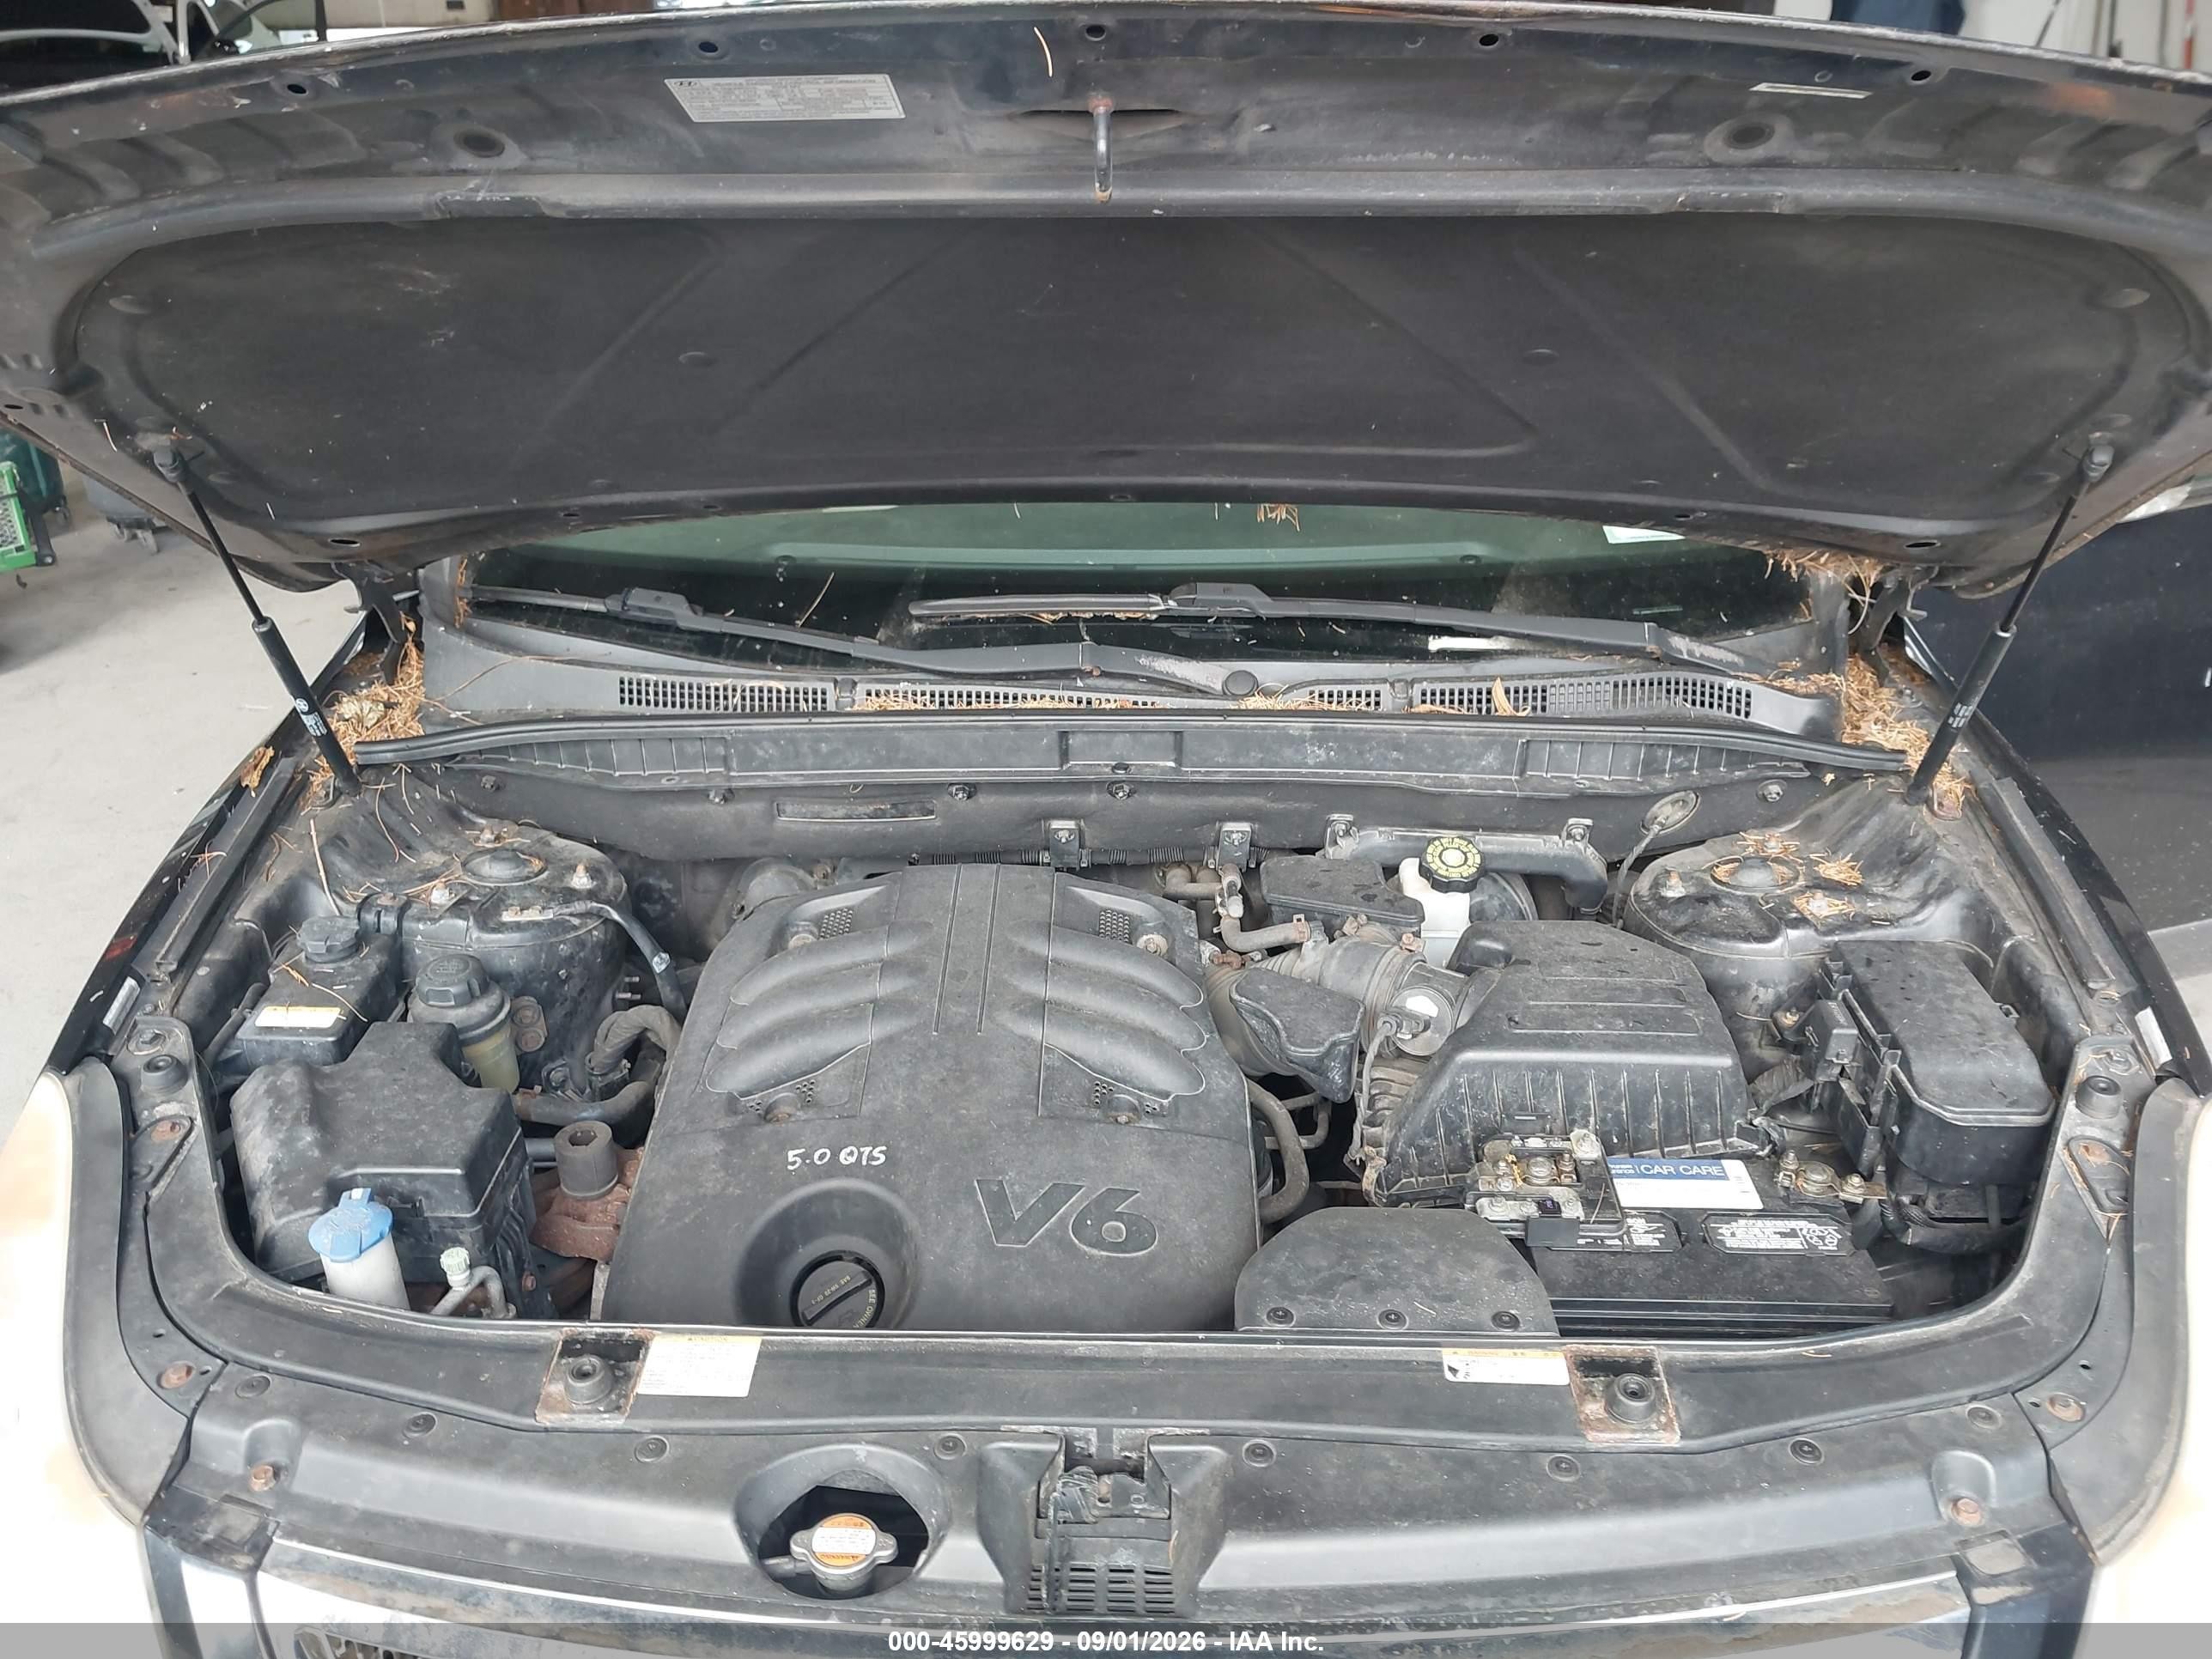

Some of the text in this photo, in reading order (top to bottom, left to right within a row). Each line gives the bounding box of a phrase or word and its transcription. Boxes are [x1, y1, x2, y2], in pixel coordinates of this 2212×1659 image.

[787, 1146, 887, 1170] 5.0 QTS
[1640, 1164, 1675, 1176] CAR
[1679, 1164, 1725, 1176] CARE
[975, 1179, 1158, 1256] V6
[868, 1289, 877, 1304] SEE
